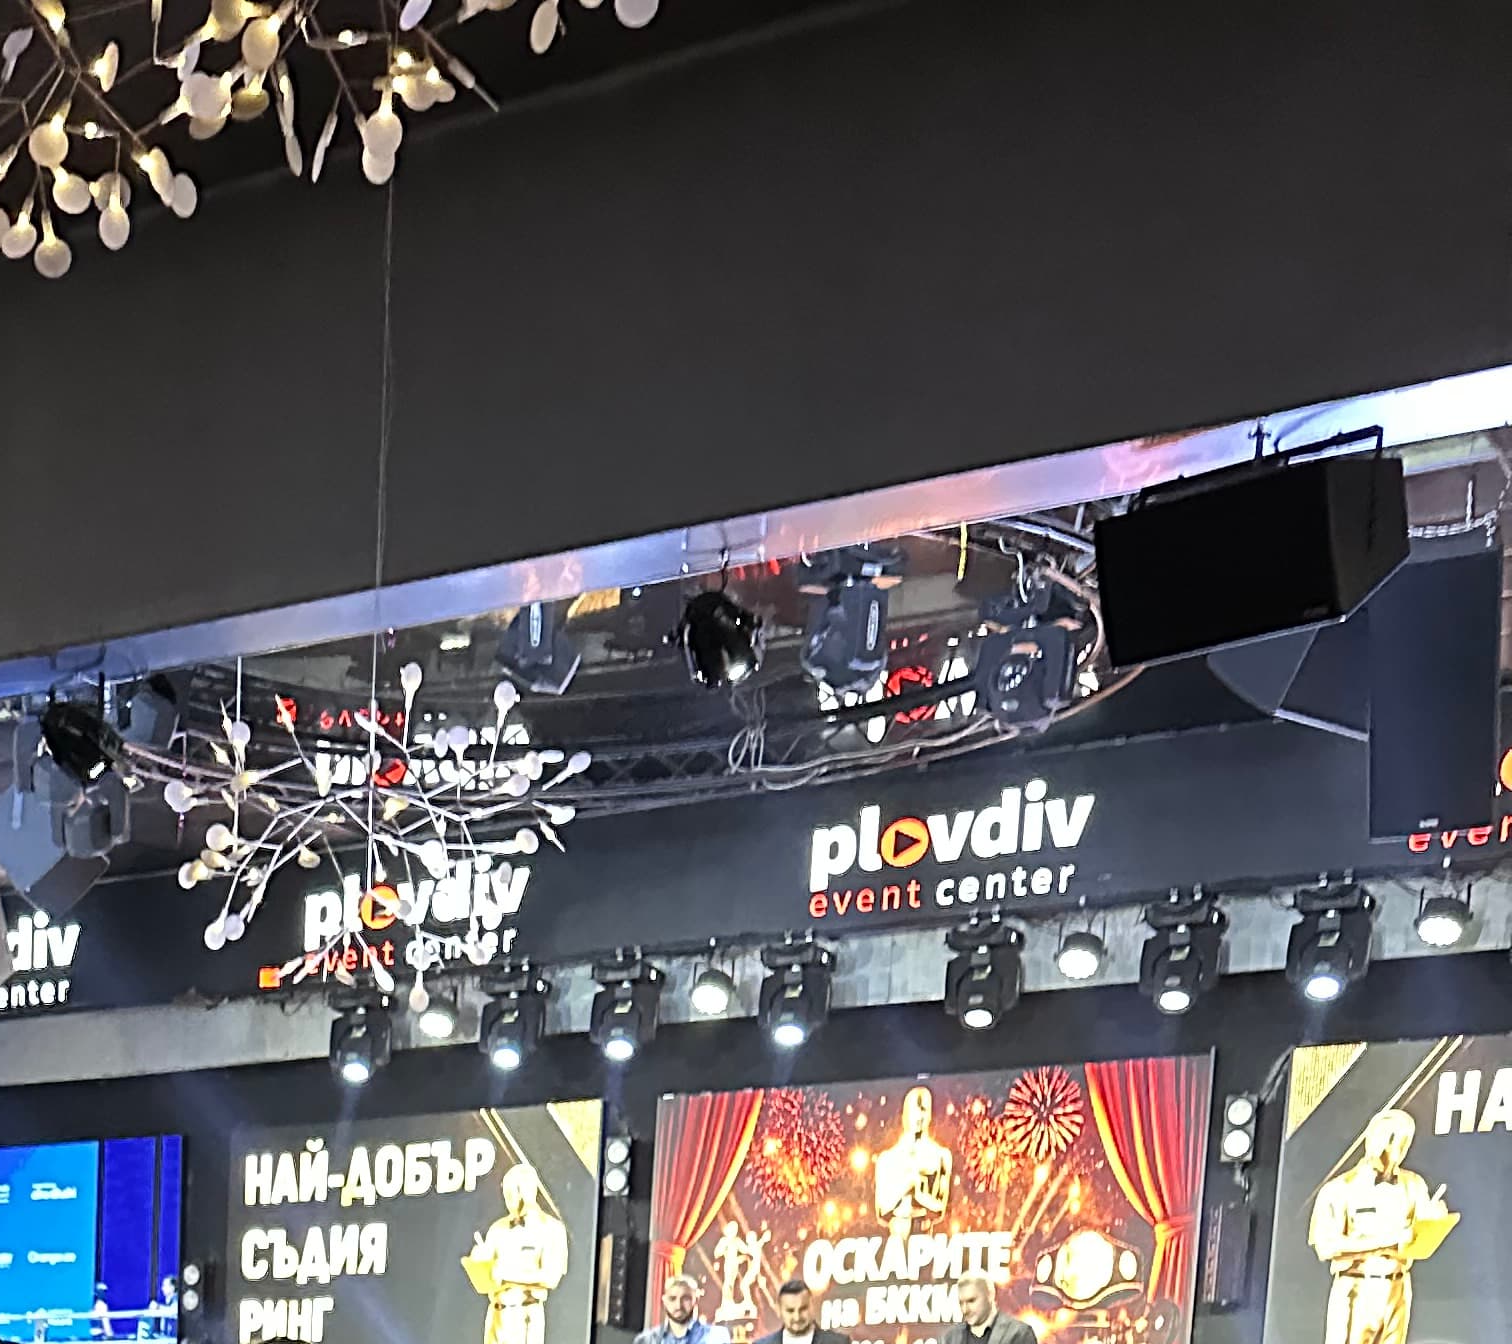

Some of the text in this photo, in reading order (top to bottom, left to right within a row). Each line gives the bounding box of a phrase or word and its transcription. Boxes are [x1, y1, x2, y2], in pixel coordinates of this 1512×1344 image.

[809, 779, 1095, 892] plovdiv
[809, 864, 1075, 917] event center
[244, 1137, 496, 1207] НАЙ-ДОБЪР
[240, 1222, 388, 1285] СЪДИЯ
[803, 1231, 1012, 1288] ОСКАРИТЕ
[239, 1296, 335, 1344] РИНГ
